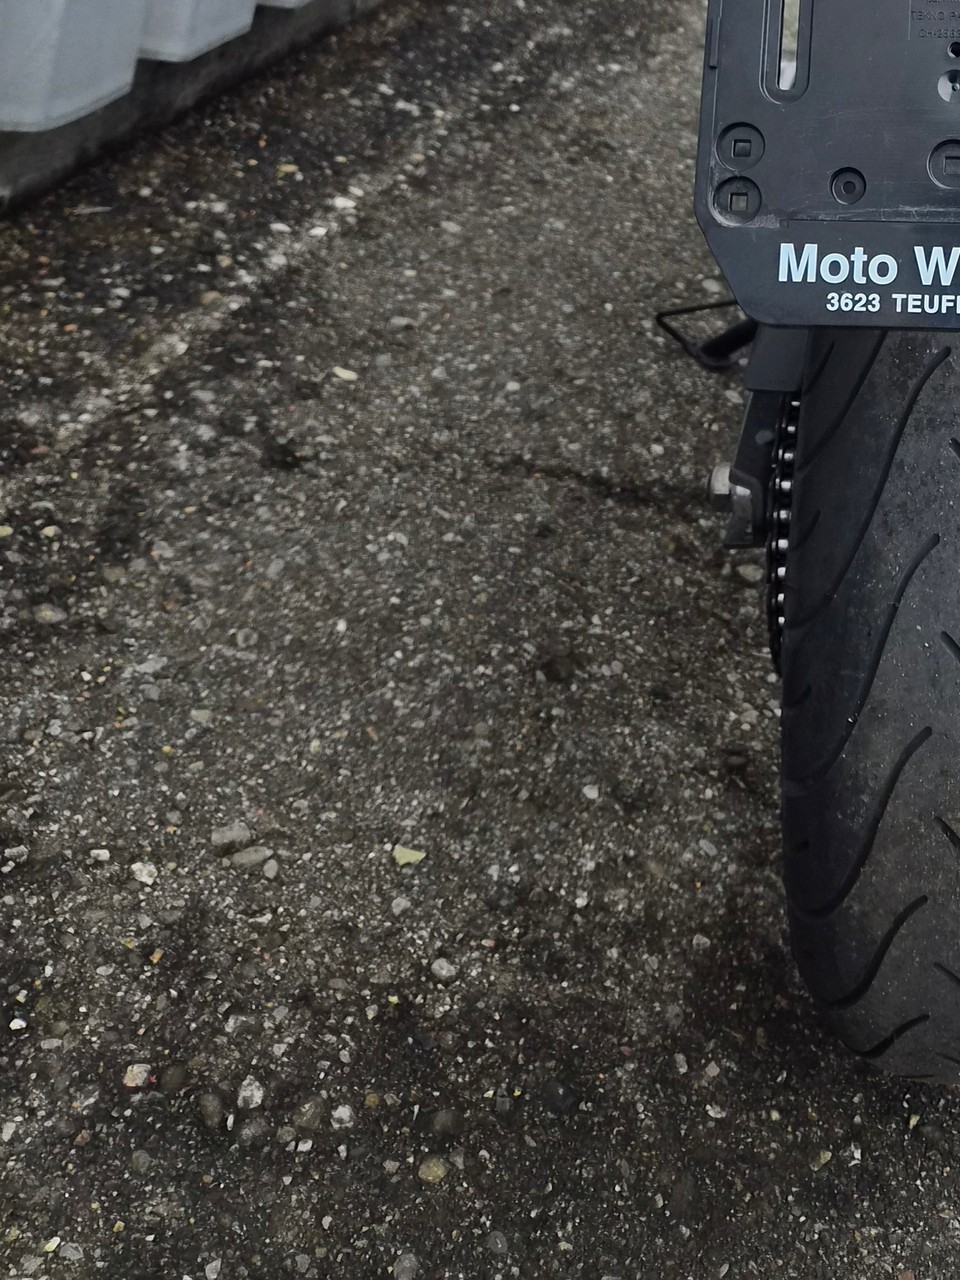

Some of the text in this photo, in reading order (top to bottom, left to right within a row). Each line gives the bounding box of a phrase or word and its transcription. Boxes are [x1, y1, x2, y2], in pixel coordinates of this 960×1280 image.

[911, 11, 945, 21] TEKNO
[779, 243, 897, 284] Moto
[826, 293, 880, 312] 3623
